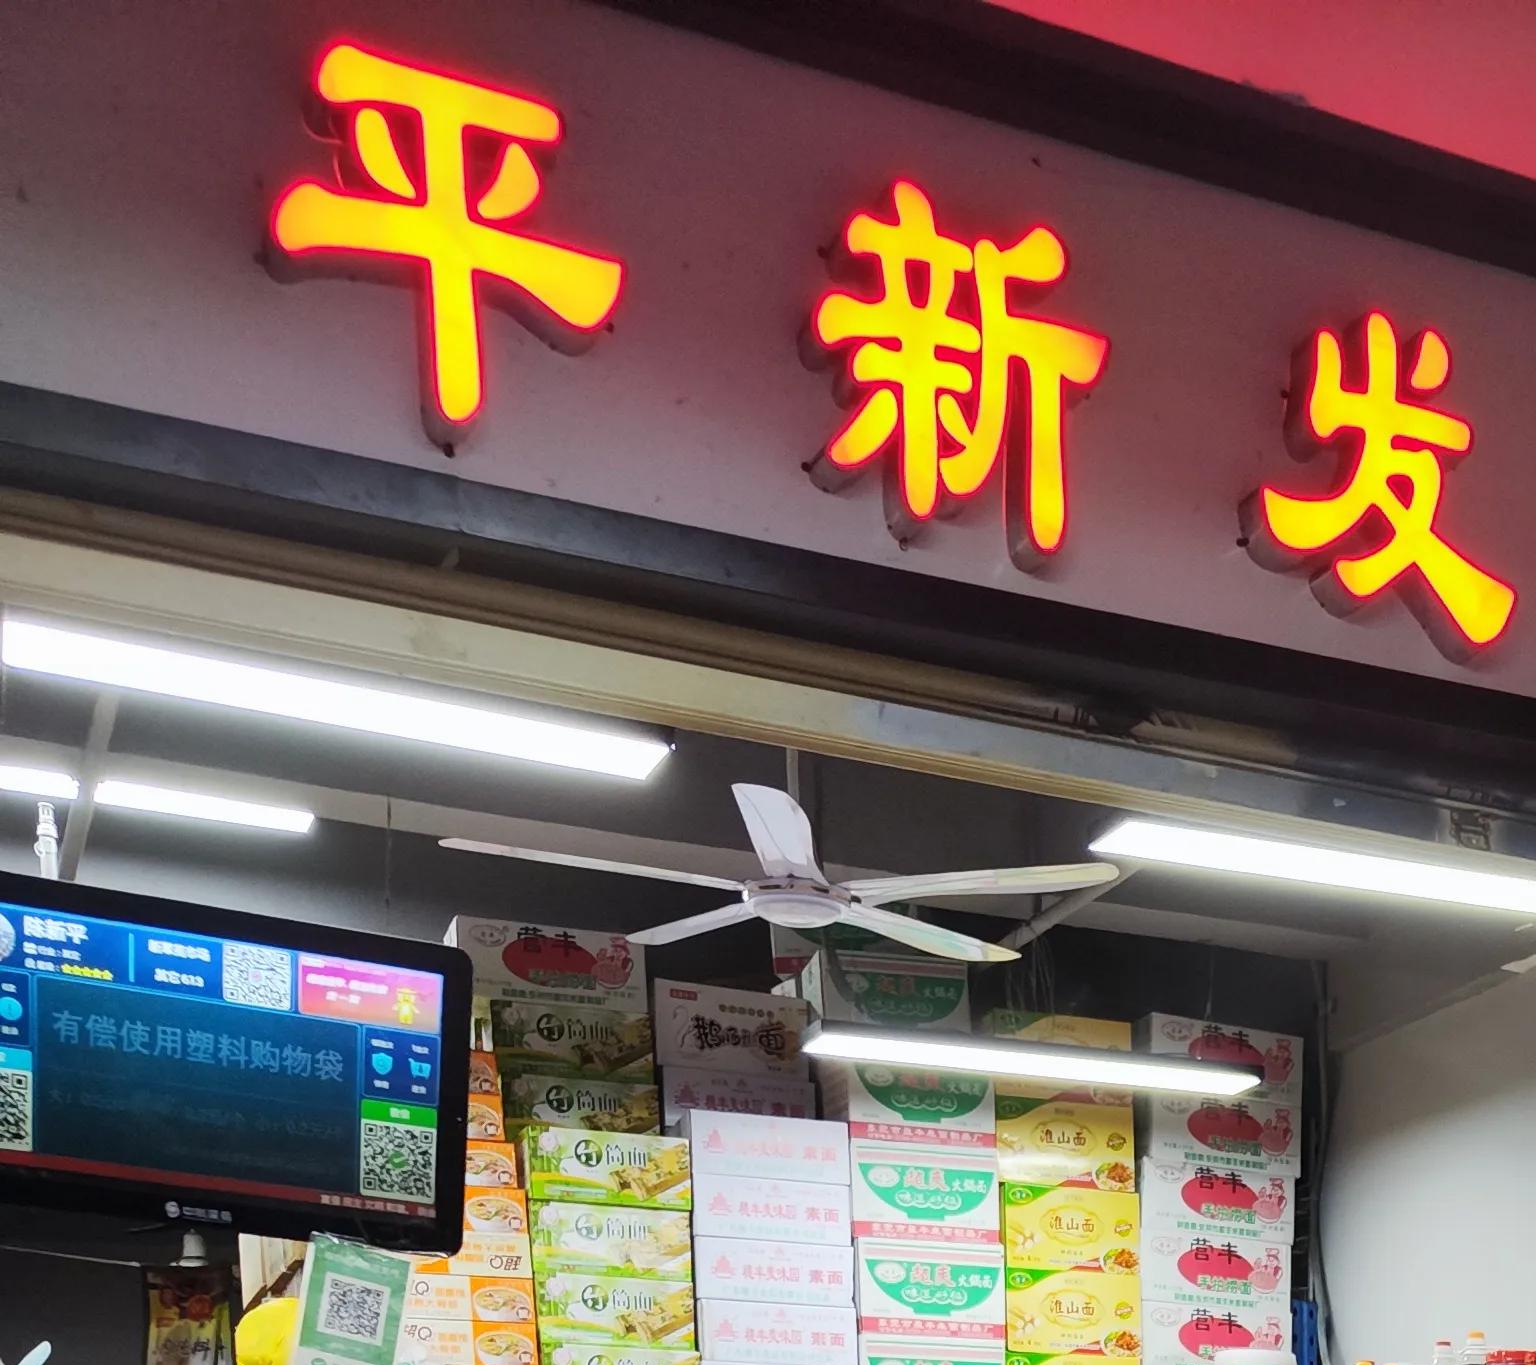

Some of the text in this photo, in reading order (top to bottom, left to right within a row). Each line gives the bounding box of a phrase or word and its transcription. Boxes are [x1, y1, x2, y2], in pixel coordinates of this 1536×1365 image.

[52, 1009, 344, 1083] 有偿使用塑料购物袋
[1194, 1167, 1248, 1194] 营丰
[1049, 1215, 1095, 1233] 淮山面
[1190, 1237, 1243, 1265] 营丰
[1049, 1299, 1095, 1317] 淮山面
[1191, 1310, 1244, 1335] 营丰
